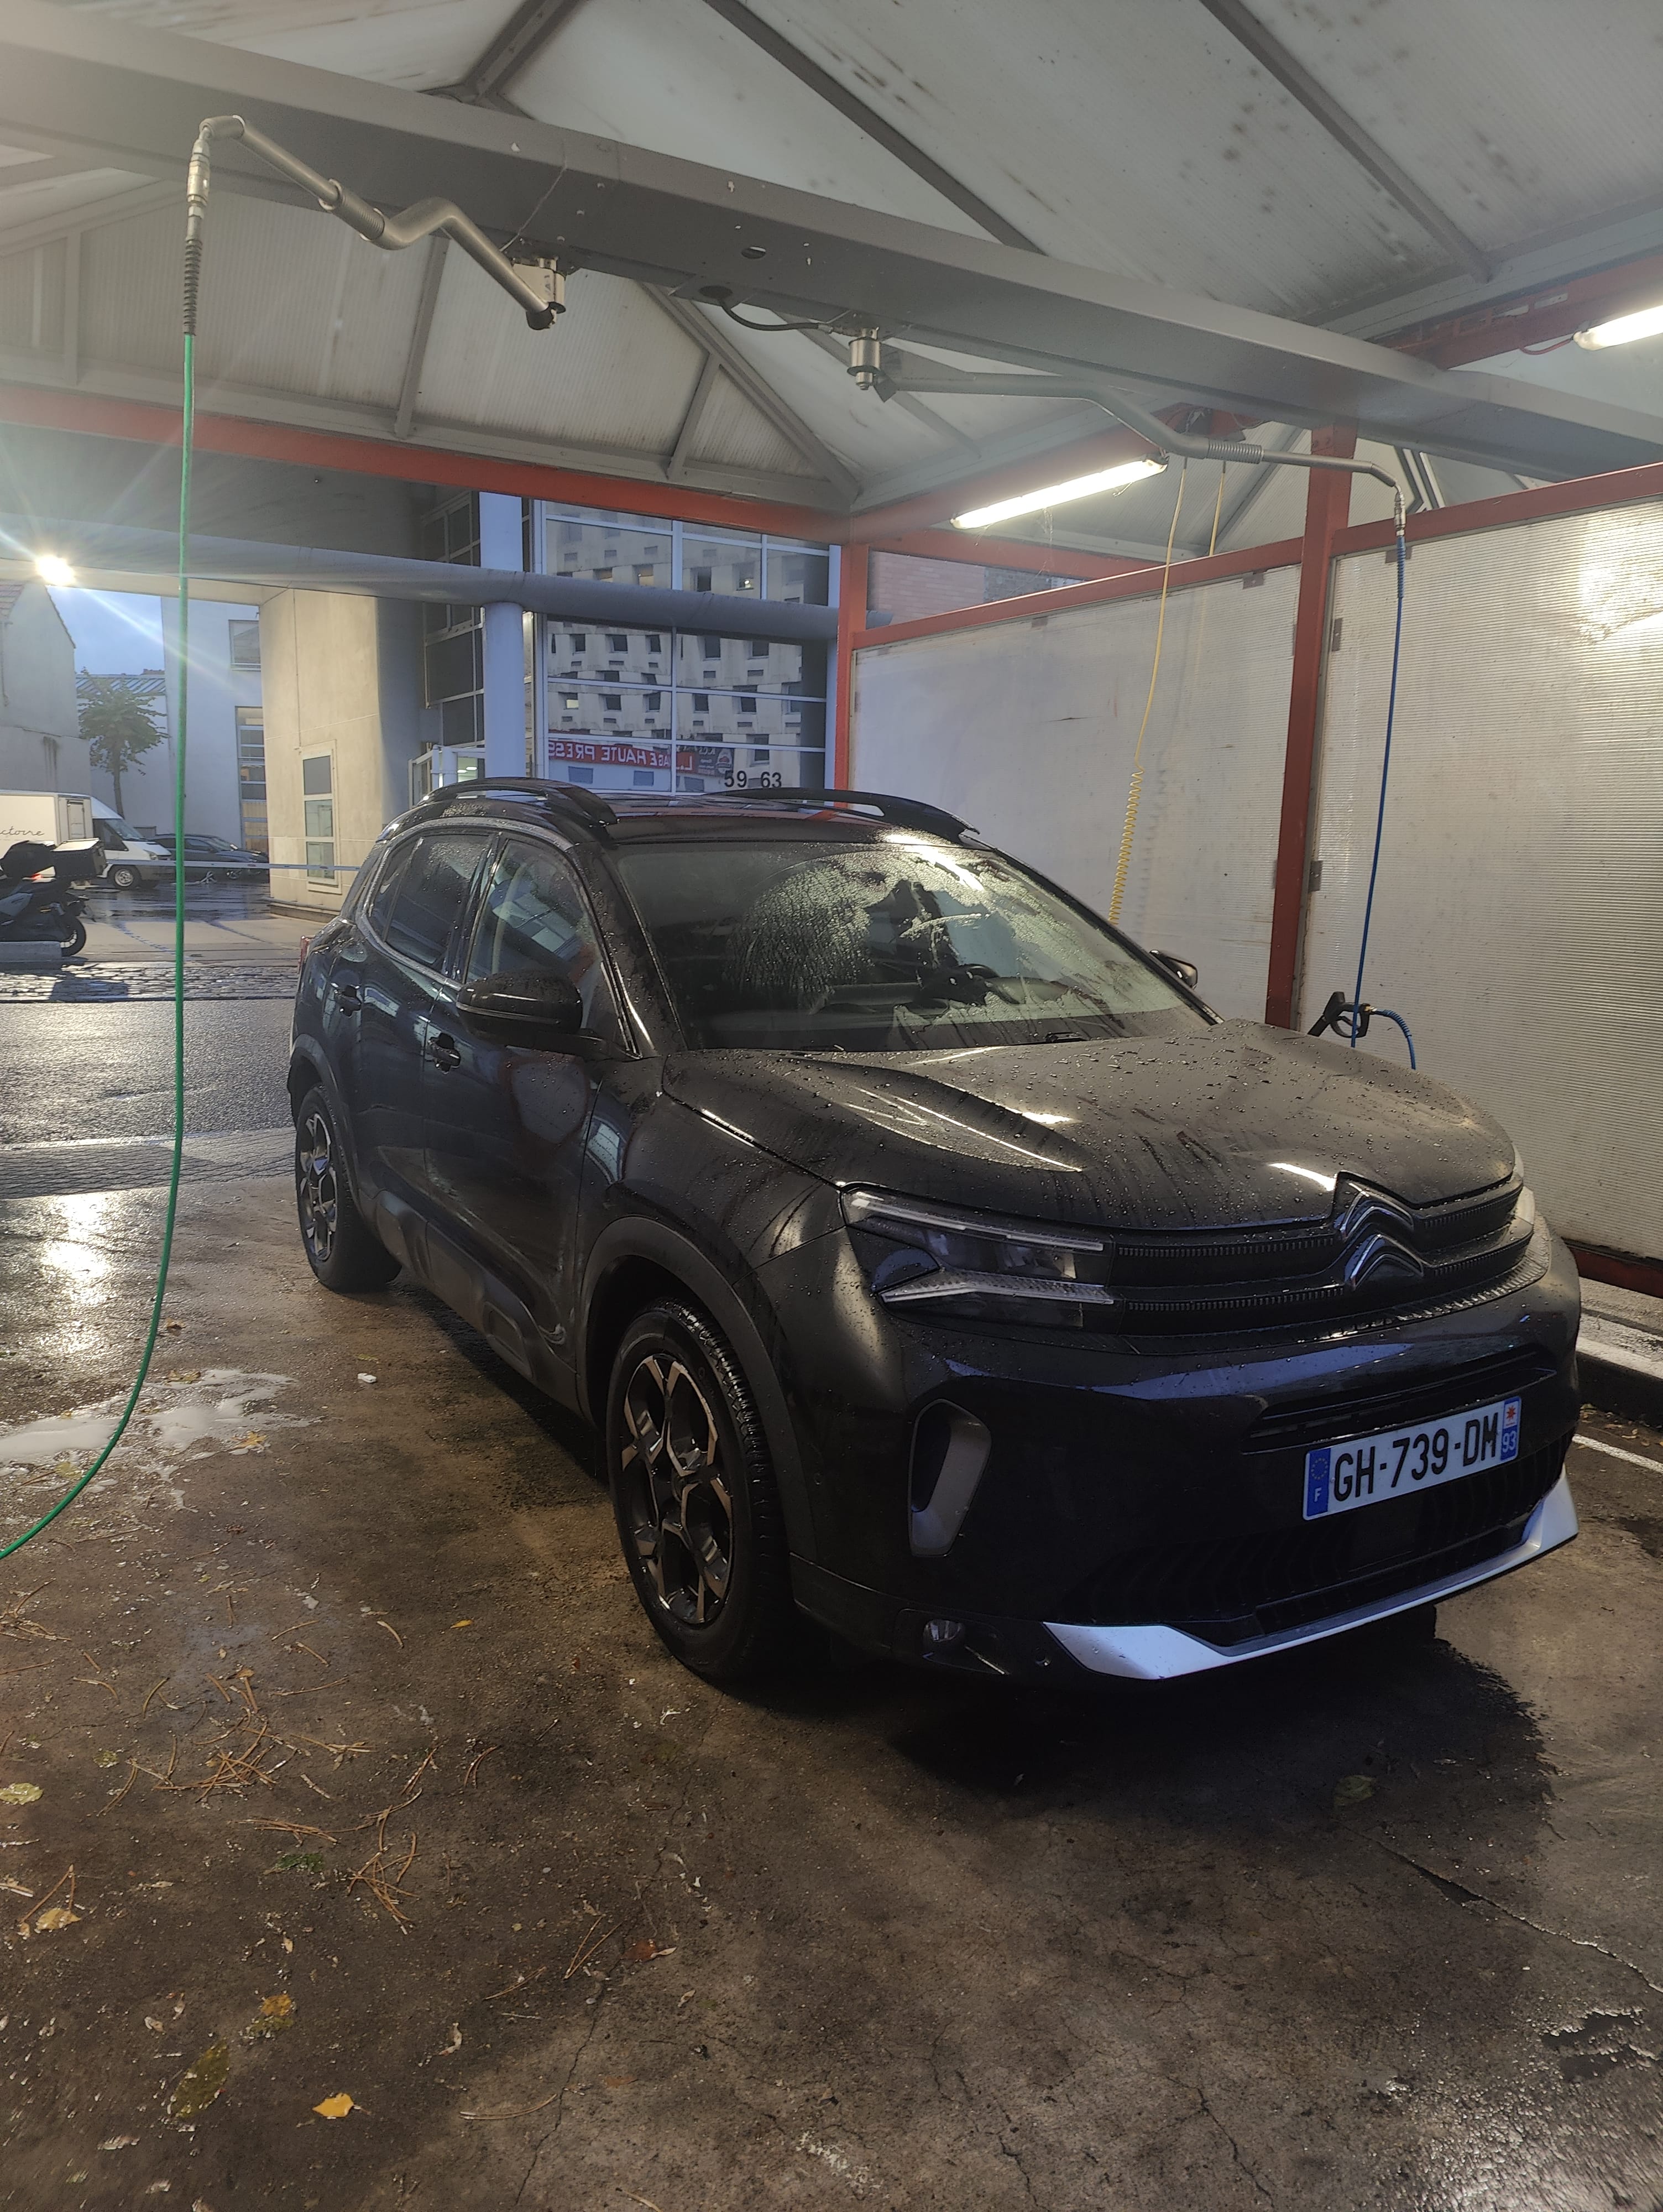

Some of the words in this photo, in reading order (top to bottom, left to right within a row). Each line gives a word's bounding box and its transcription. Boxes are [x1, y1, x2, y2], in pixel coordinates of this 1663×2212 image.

[724, 770, 747, 788] 59
[760, 771, 782, 789] 63
[1313, 1487, 1322, 1503] F
[1333, 1412, 1499, 1502] GH-739-DM
[1502, 1430, 1516, 1453] 93
